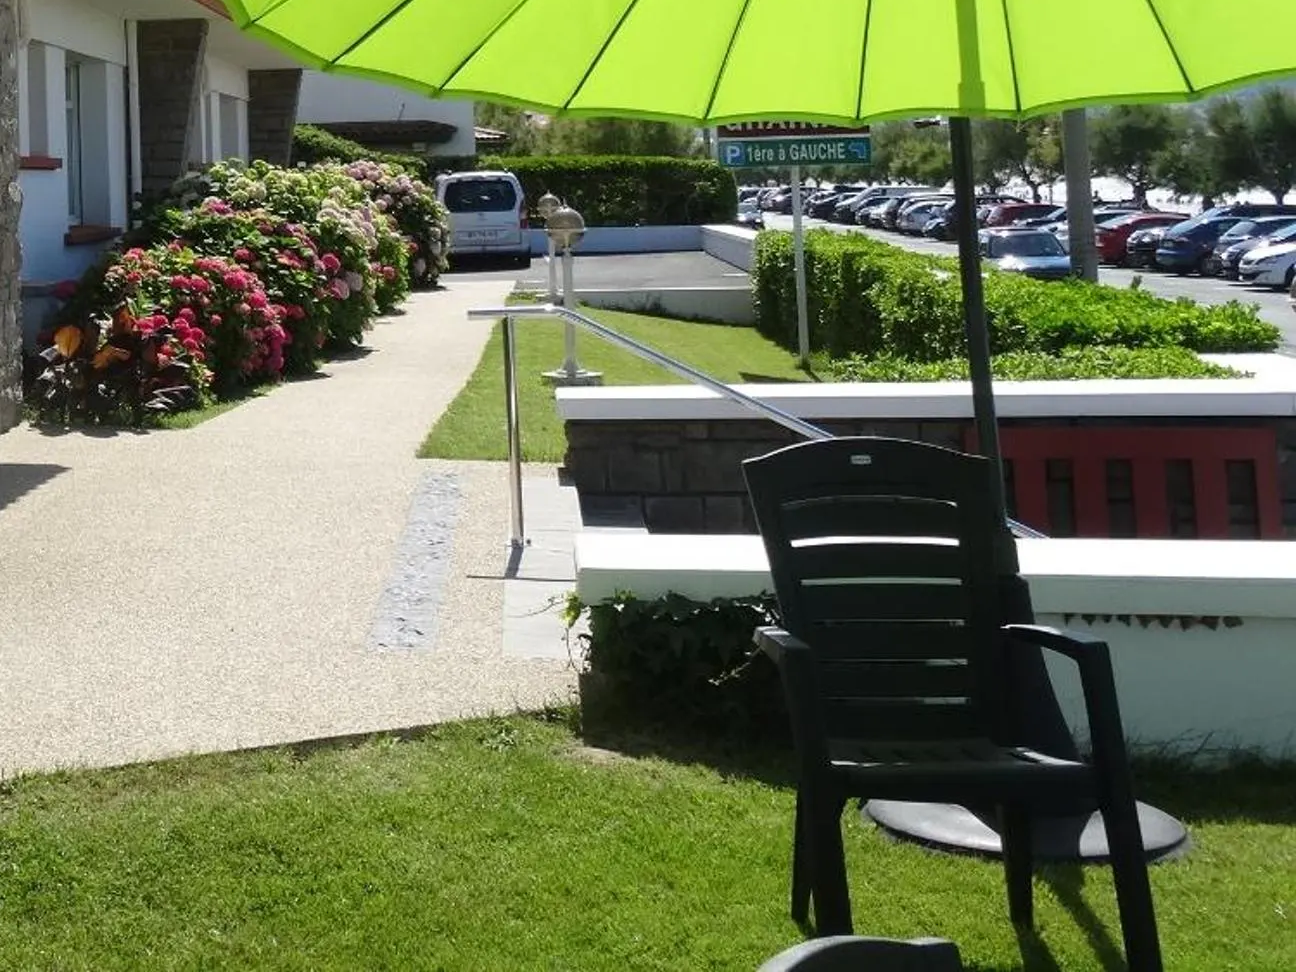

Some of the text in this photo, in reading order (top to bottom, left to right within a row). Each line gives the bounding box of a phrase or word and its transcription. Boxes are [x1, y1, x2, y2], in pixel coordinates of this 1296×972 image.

[726, 142, 846, 164] P 1ère à GAUCHE
